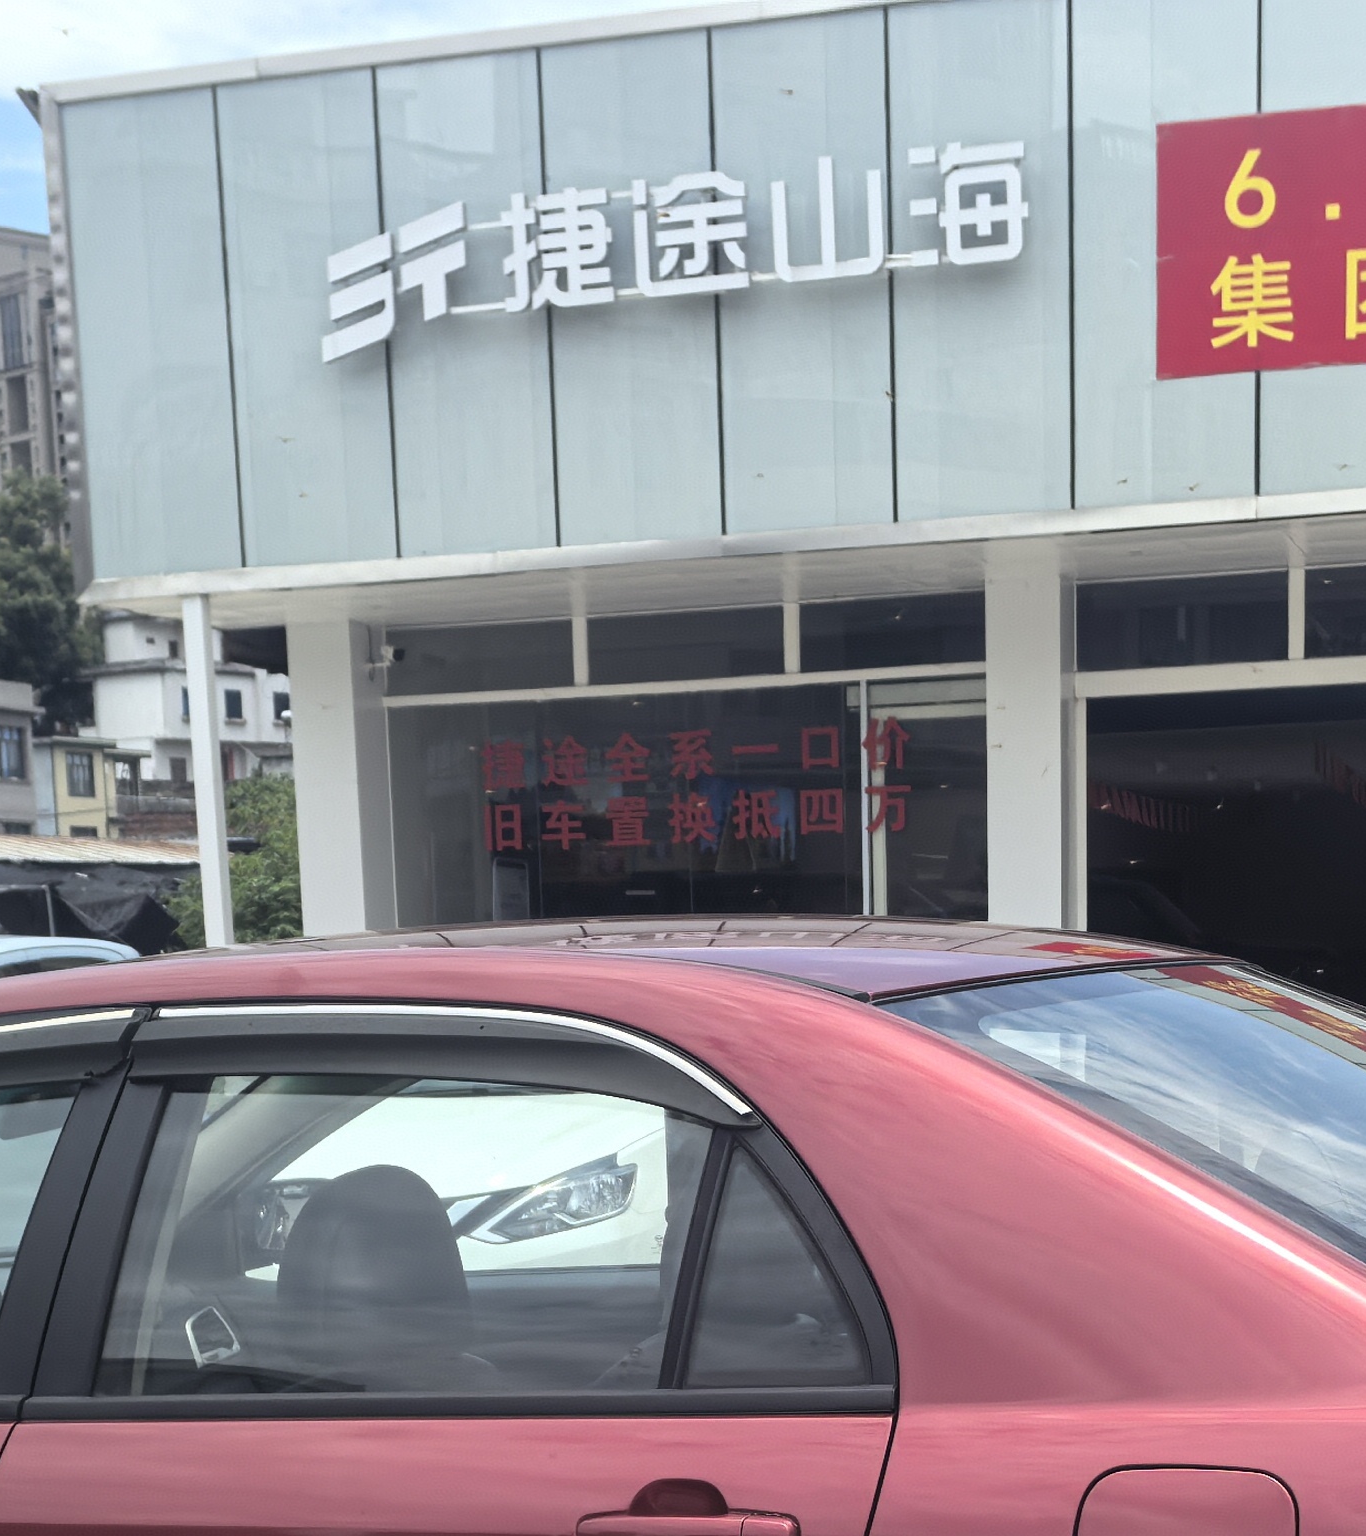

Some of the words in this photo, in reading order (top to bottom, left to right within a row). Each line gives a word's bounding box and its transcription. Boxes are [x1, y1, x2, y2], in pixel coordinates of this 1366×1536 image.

[500, 141, 1029, 313] 捷途山海
[482, 717, 910, 791] 捷途全系一口价
[484, 785, 911, 851] 旧车置换抵四万
